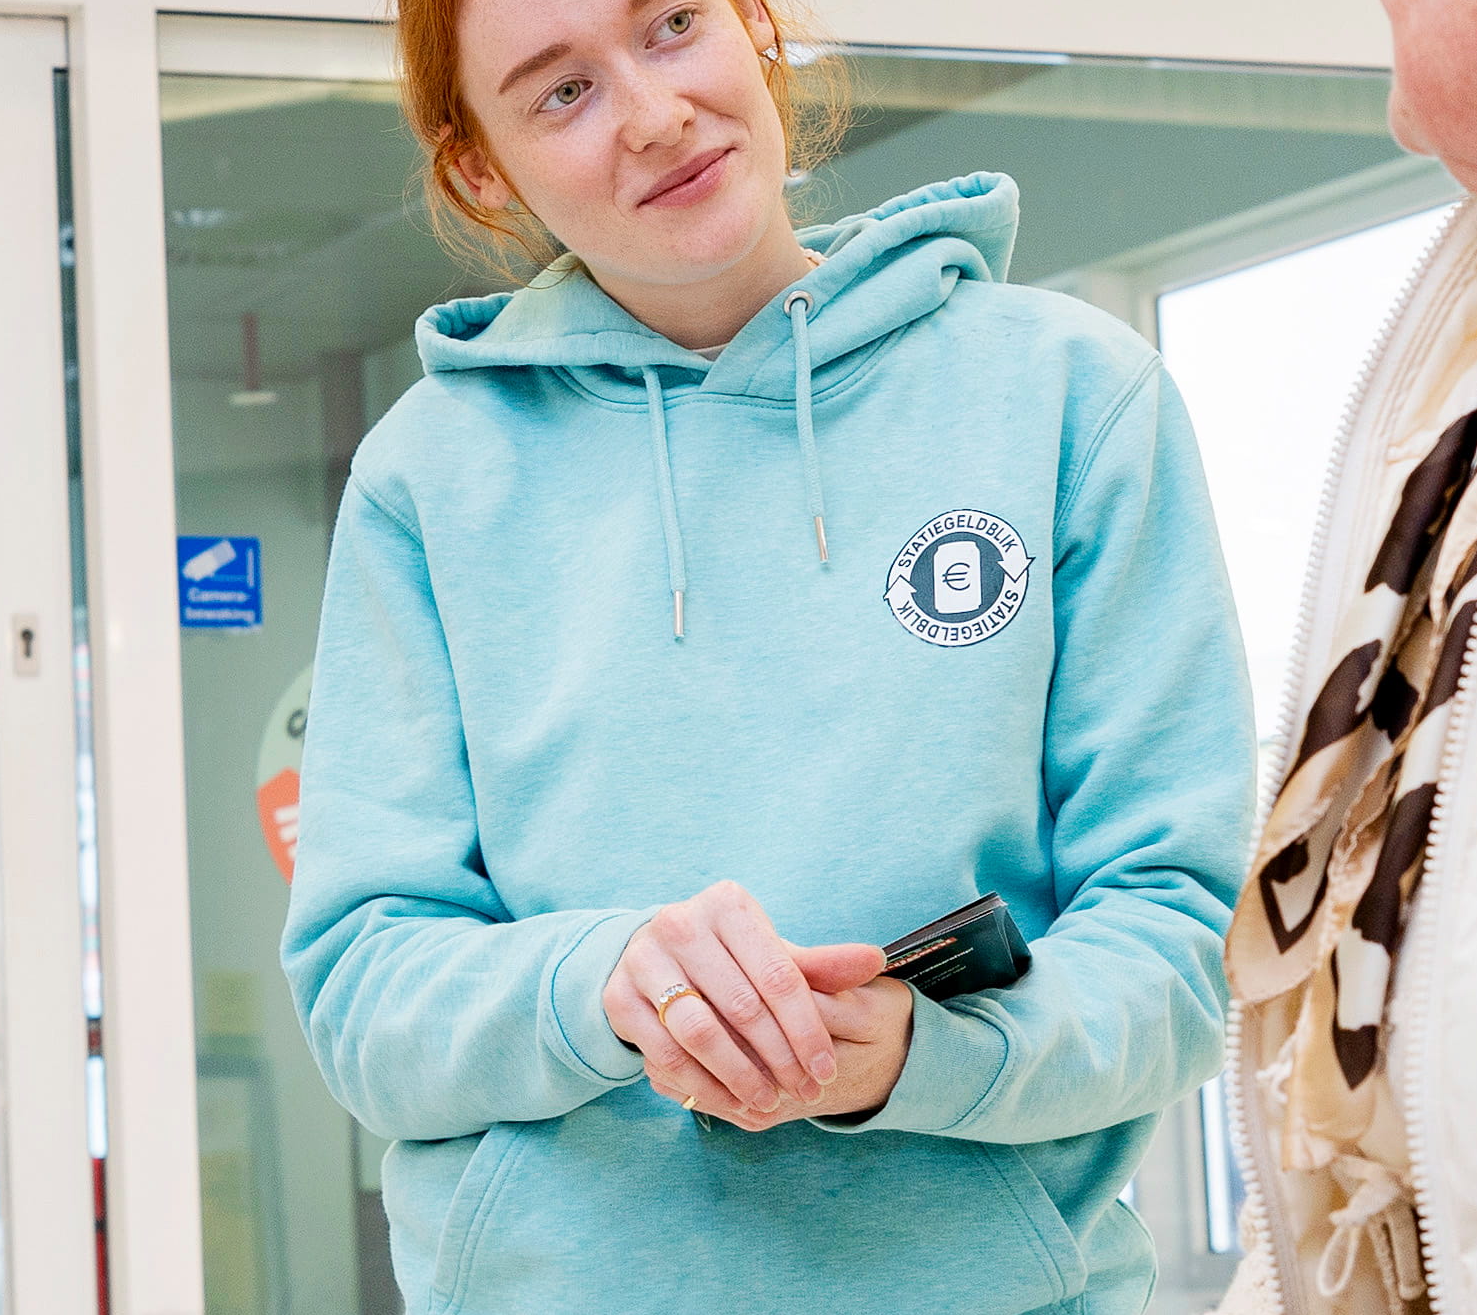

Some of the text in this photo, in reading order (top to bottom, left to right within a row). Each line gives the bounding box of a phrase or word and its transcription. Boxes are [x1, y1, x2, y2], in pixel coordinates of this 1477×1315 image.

[898, 515, 1018, 568] STATIEGELDBLIK
[942, 562, 970, 591] €
[897, 589, 1018, 641] STATIEGELDBLIK
